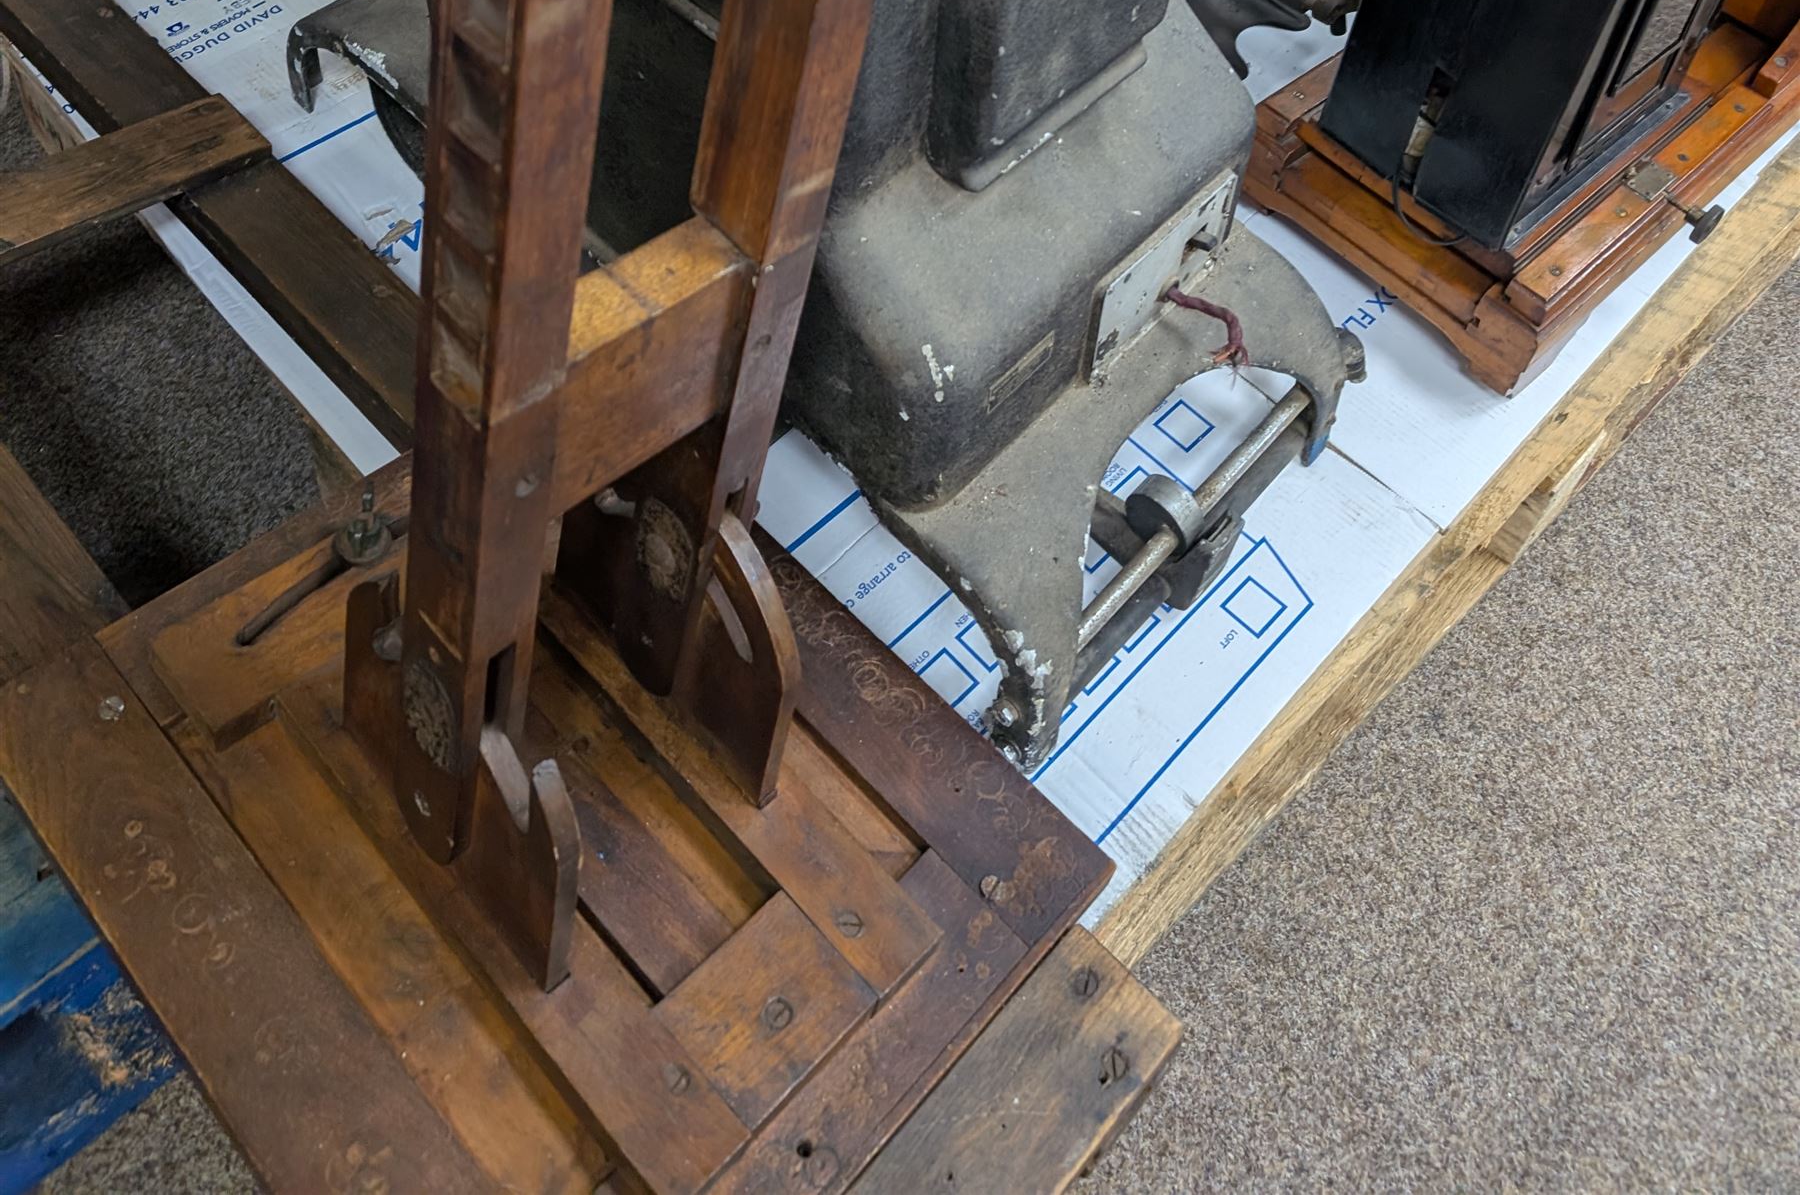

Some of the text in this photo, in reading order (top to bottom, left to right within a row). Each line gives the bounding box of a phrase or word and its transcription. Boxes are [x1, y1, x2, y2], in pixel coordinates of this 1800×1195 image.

[209, 6, 251, 32] MOVERS
[232, 3, 282, 34] DAVID
[200, 27, 209, 36] &
[1341, 307, 1376, 330] FL
[895, 550, 911, 566] to
[855, 562, 897, 600] arrange
[1219, 629, 1238, 649] LOFT
